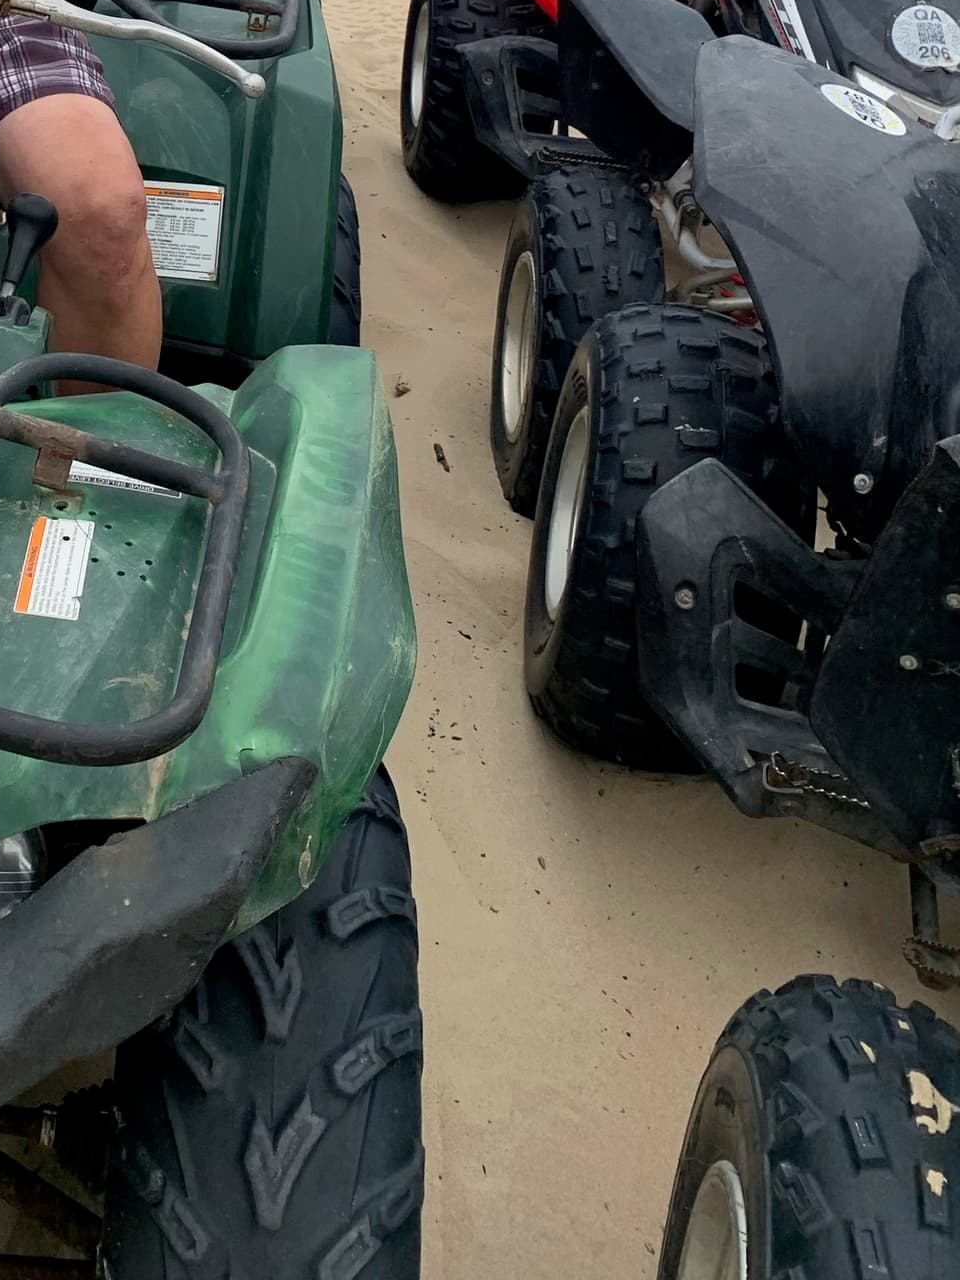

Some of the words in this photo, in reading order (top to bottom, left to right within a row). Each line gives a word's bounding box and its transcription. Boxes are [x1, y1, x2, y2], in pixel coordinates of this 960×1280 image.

[913, 9, 942, 22] QA
[918, 46, 950, 61] 206
[95, 476, 128, 487] SELECT
[129, 481, 155, 492] DRIVE
